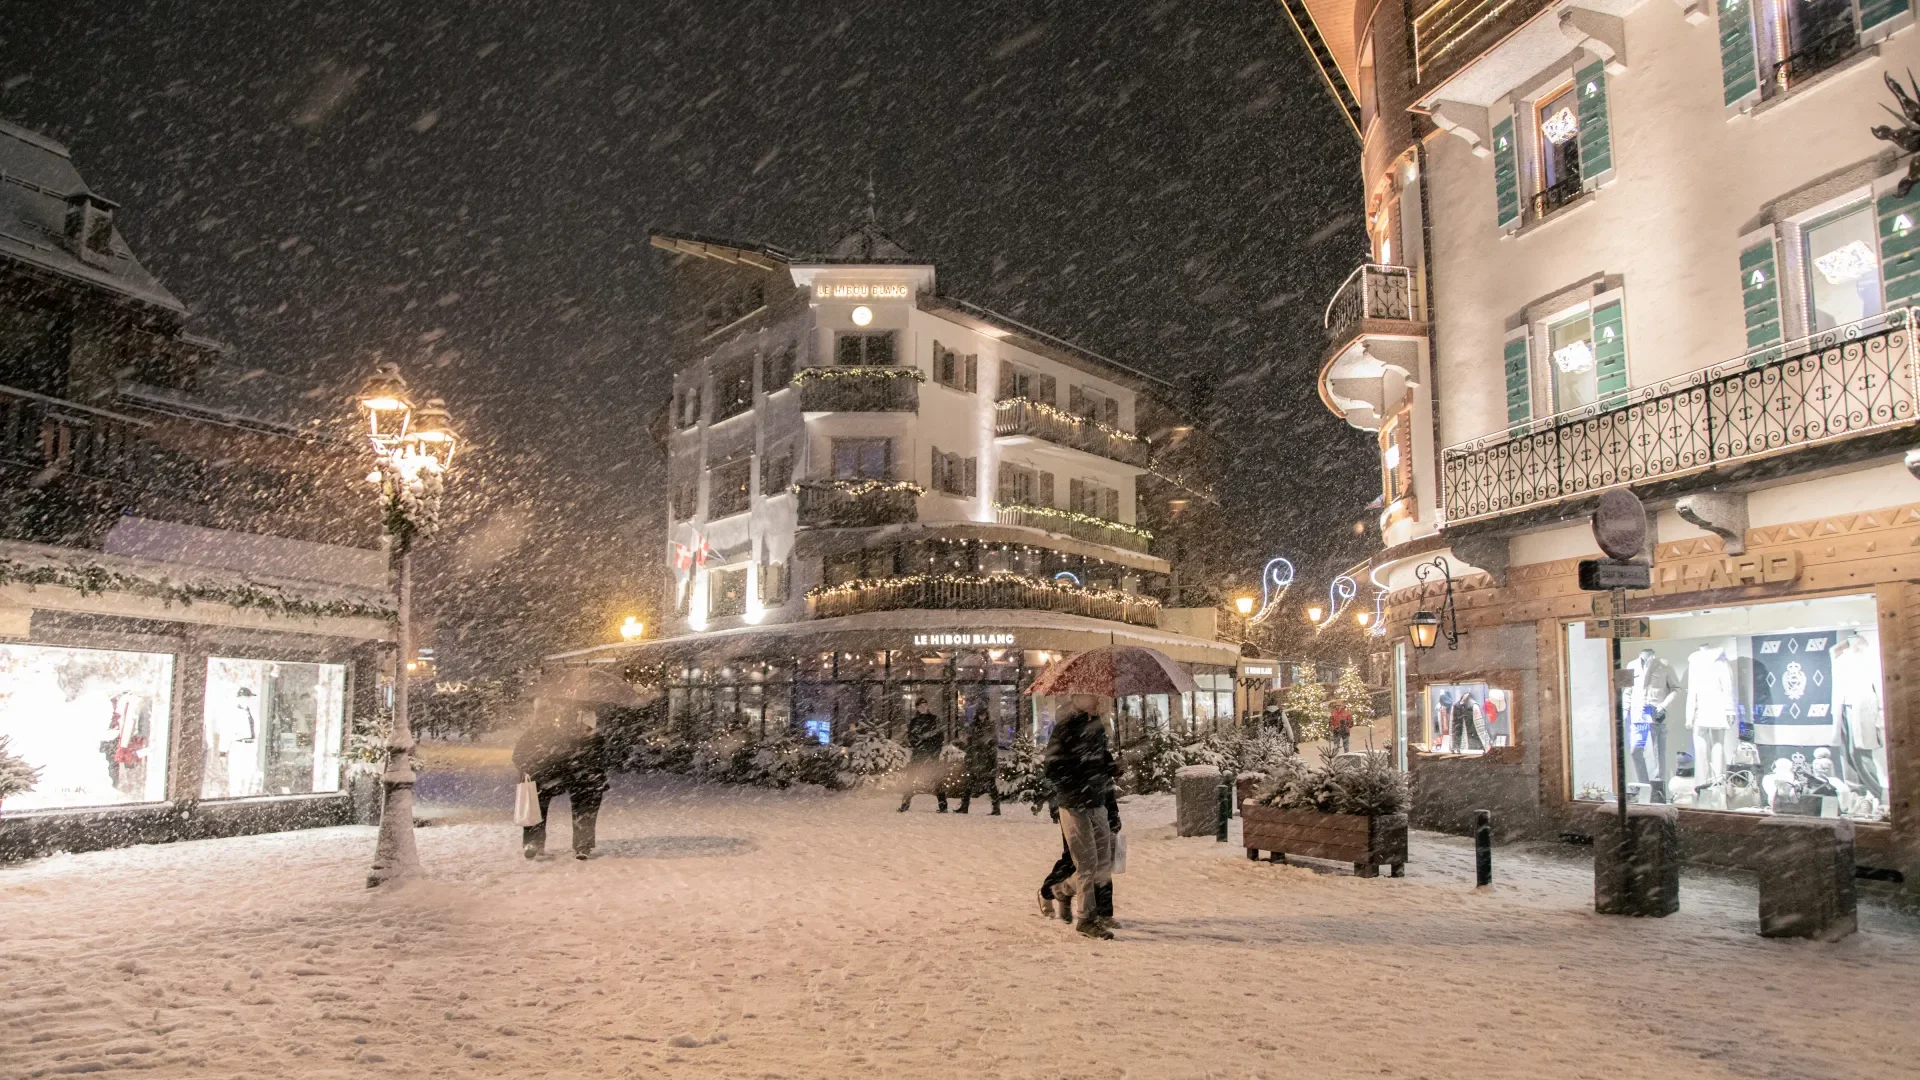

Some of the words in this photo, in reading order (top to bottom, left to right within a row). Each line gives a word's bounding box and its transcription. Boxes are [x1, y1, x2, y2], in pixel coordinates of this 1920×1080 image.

[817, 285, 830, 297] LE
[834, 285, 869, 297] HIBOU
[872, 285, 908, 297] BLANC
[1622, 549, 1802, 599] LLARD
[914, 635, 928, 645] LE
[930, 634, 971, 645] HIBOU
[973, 634, 1014, 645] BLANC
